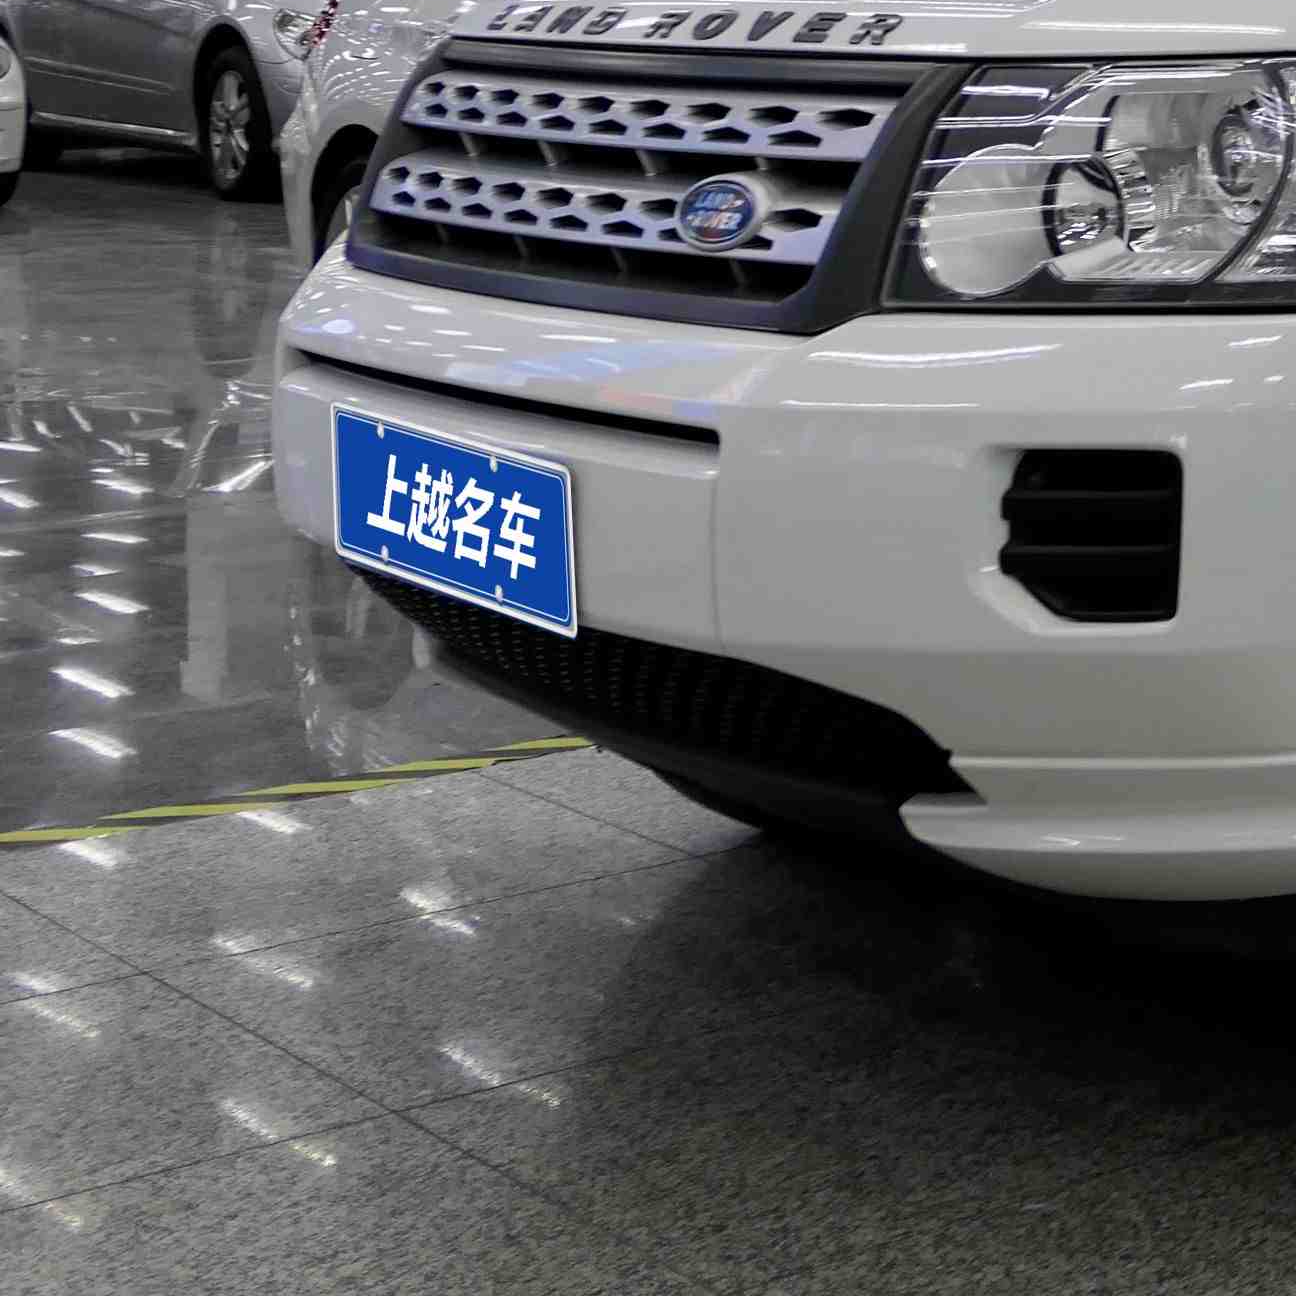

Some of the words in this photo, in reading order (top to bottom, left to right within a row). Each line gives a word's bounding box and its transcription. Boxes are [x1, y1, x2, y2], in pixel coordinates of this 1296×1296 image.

[487, 4, 629, 36] LAND
[643, 7, 904, 46] ROVER
[366, 454, 541, 580] 上越名车
